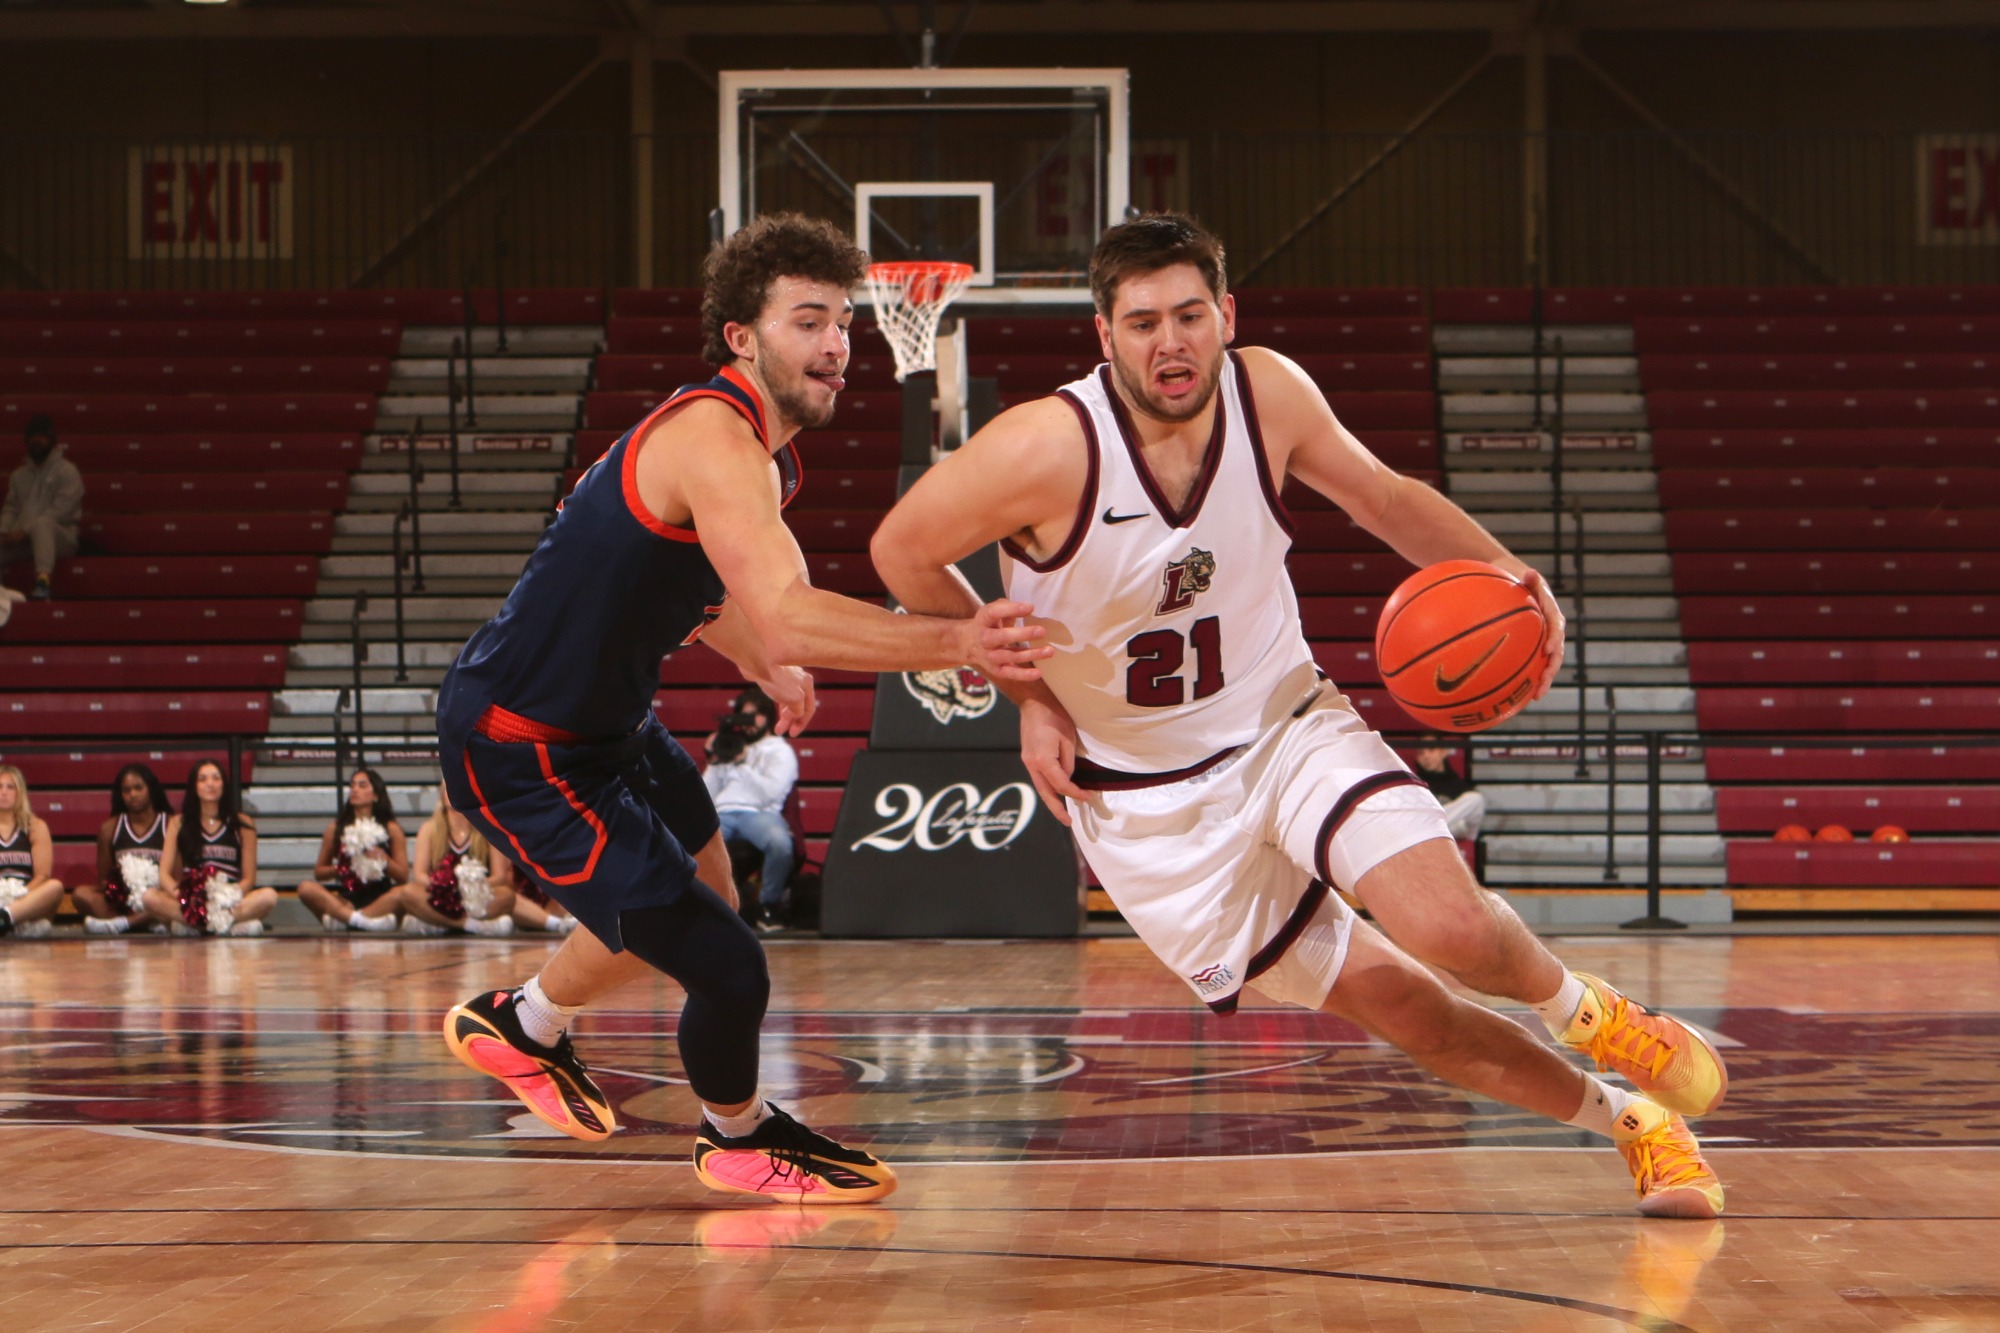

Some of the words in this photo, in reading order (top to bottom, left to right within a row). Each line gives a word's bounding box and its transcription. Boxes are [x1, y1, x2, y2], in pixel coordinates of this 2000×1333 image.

[142, 161, 284, 243] EXIT
[1933, 149, 2000, 229] EX
[1126, 615, 1225, 707] 21
[1451, 678, 1533, 727] ELITE
[850, 782, 1037, 852] 200
[931, 799, 1019, 836] Lafayette
